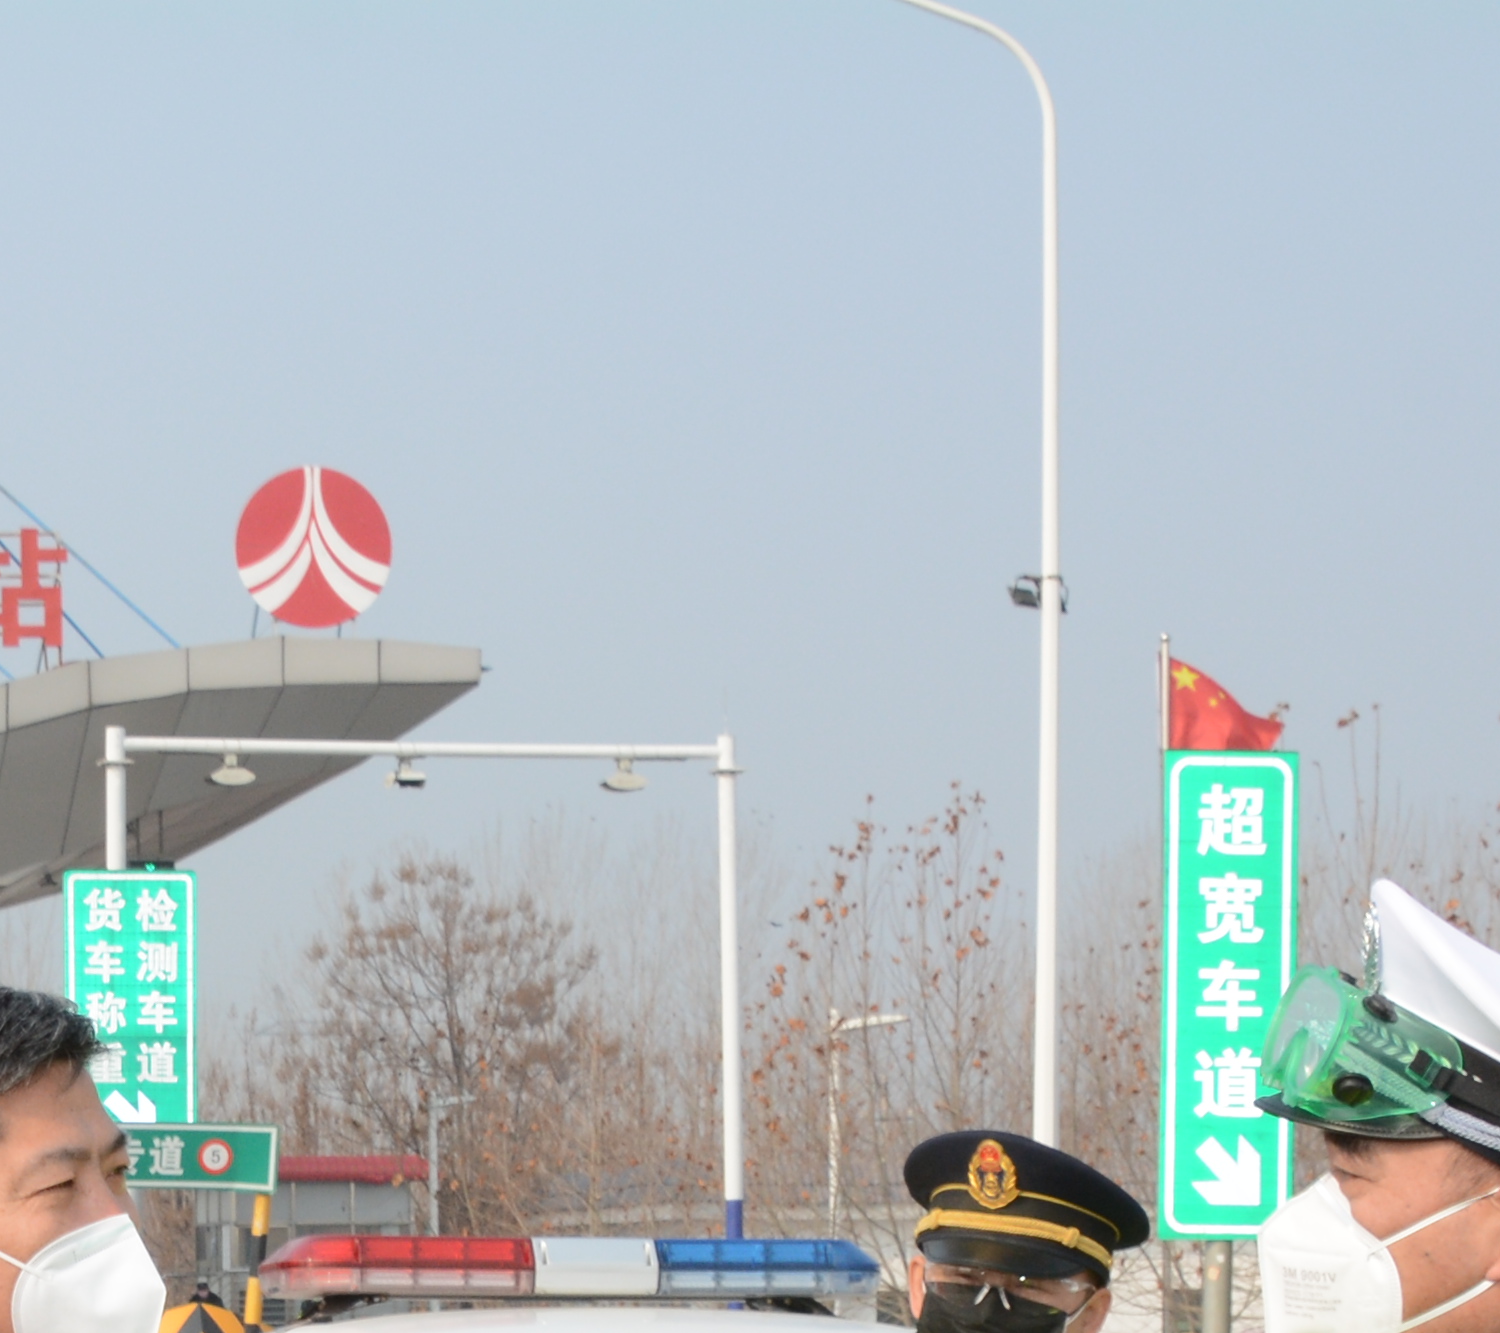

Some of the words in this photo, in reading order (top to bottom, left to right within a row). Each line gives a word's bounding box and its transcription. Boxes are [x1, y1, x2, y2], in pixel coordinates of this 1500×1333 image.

[84, 887, 126, 1085] 货车称重
[136, 887, 178, 1085] 检测车道
[1195, 785, 1267, 1118] 超宽车道
[211, 1149, 221, 1164] 5
